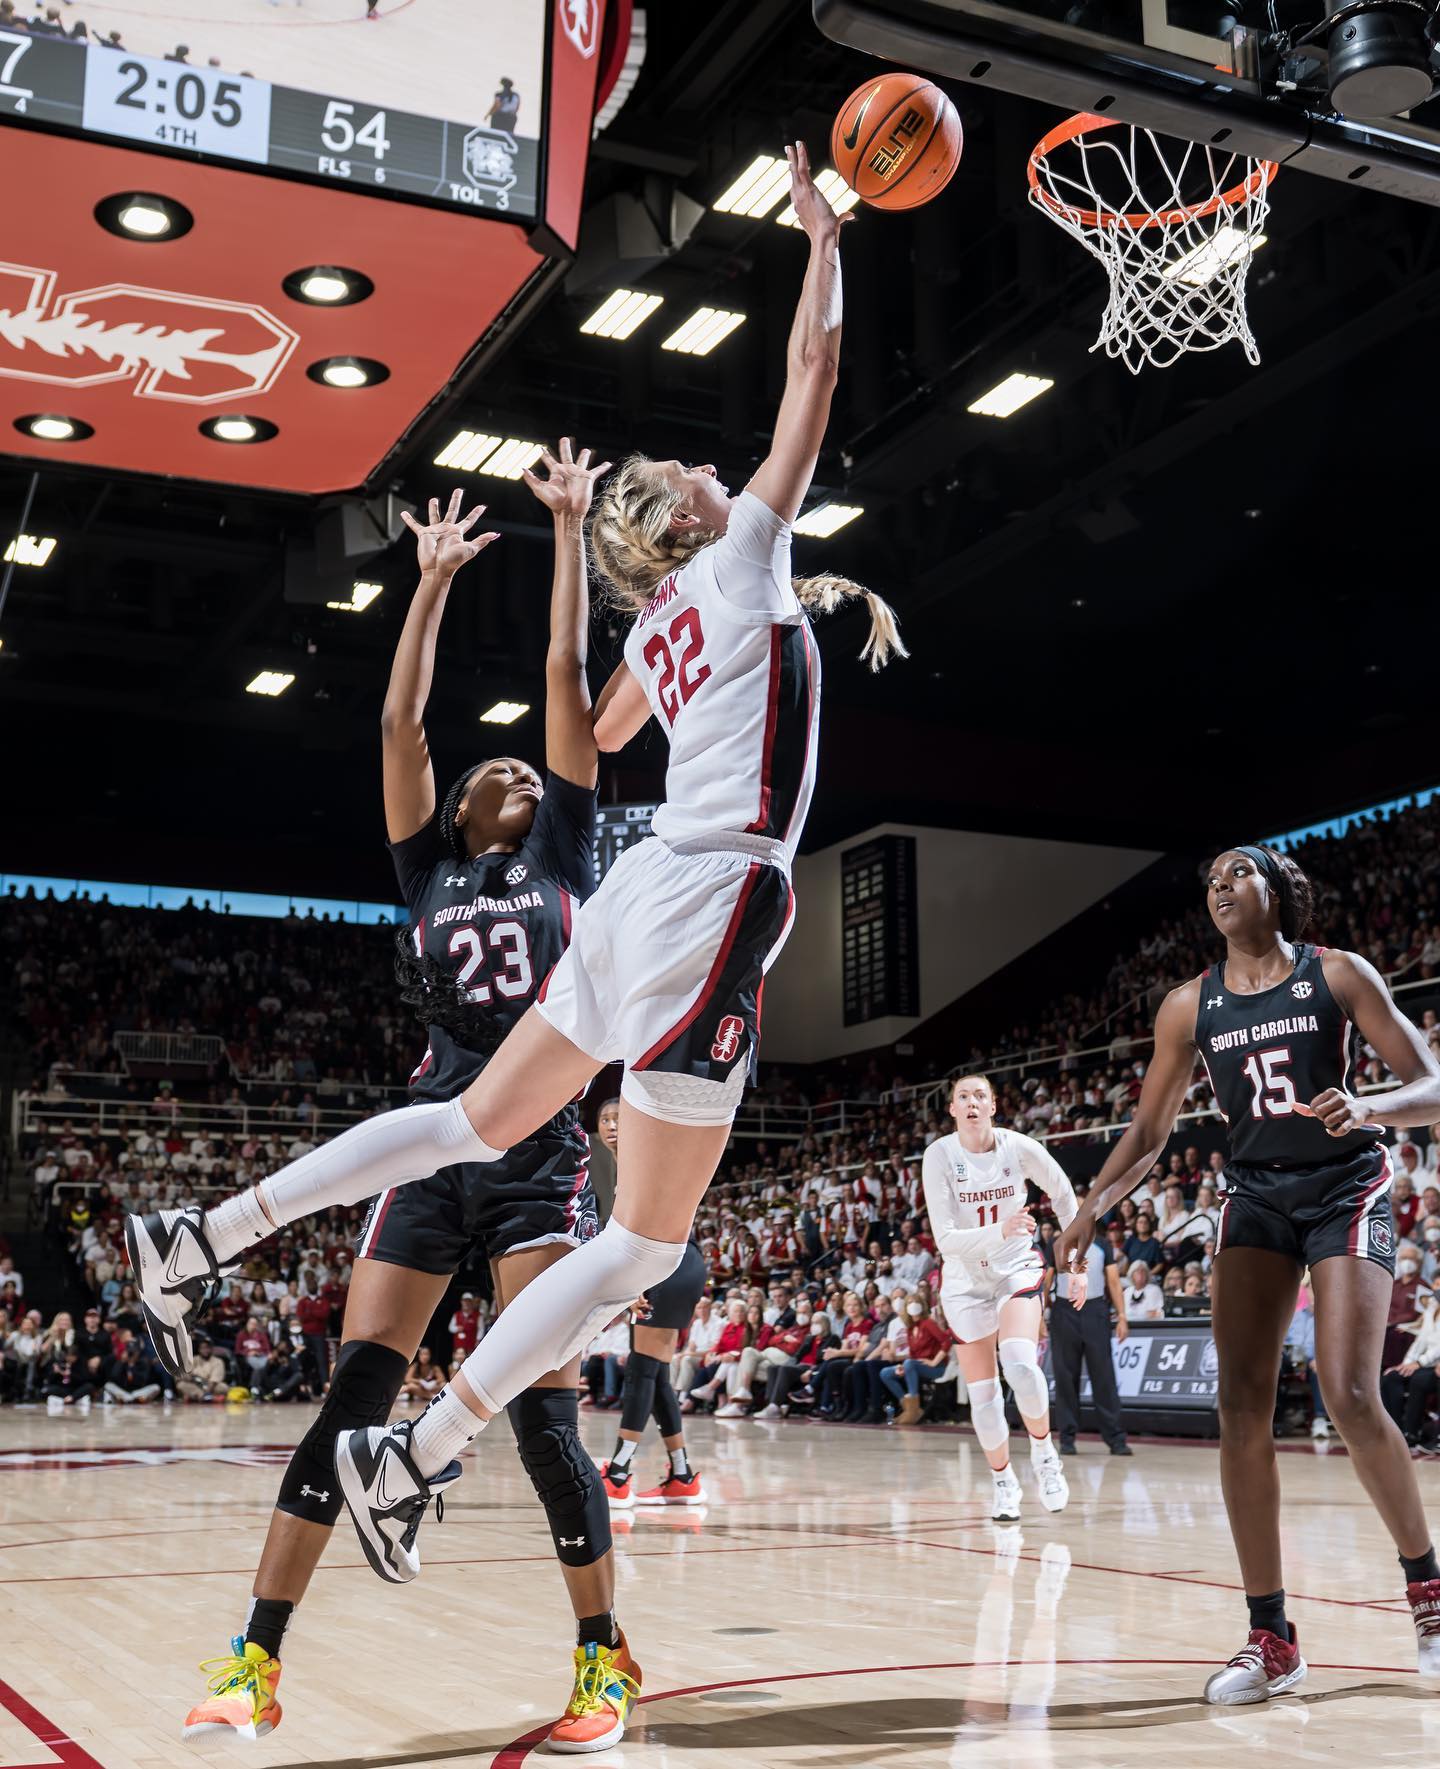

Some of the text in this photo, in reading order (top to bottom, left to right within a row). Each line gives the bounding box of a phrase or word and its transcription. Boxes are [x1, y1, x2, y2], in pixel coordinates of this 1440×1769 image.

[115, 60, 242, 128] 2:05
[154, 123, 197, 146] 4TH
[320, 99, 391, 160] 54
[868, 107, 926, 177] ELITE
[318, 155, 351, 178] FLS
[449, 183, 510, 210] TOL 3
[642, 605, 712, 729] 22
[505, 864, 528, 885] SEC
[432, 904, 475, 928] SOUTH
[449, 919, 533, 1004] 23
[1291, 981, 1313, 999] SEC
[1210, 1015, 1319, 1052] SOUTH CAROLINA
[1243, 1048, 1296, 1118] 15
[959, 1185, 1015, 1203] STANFORD
[976, 1204, 998, 1228] 11
[1158, 1344, 1188, 1371] 54
